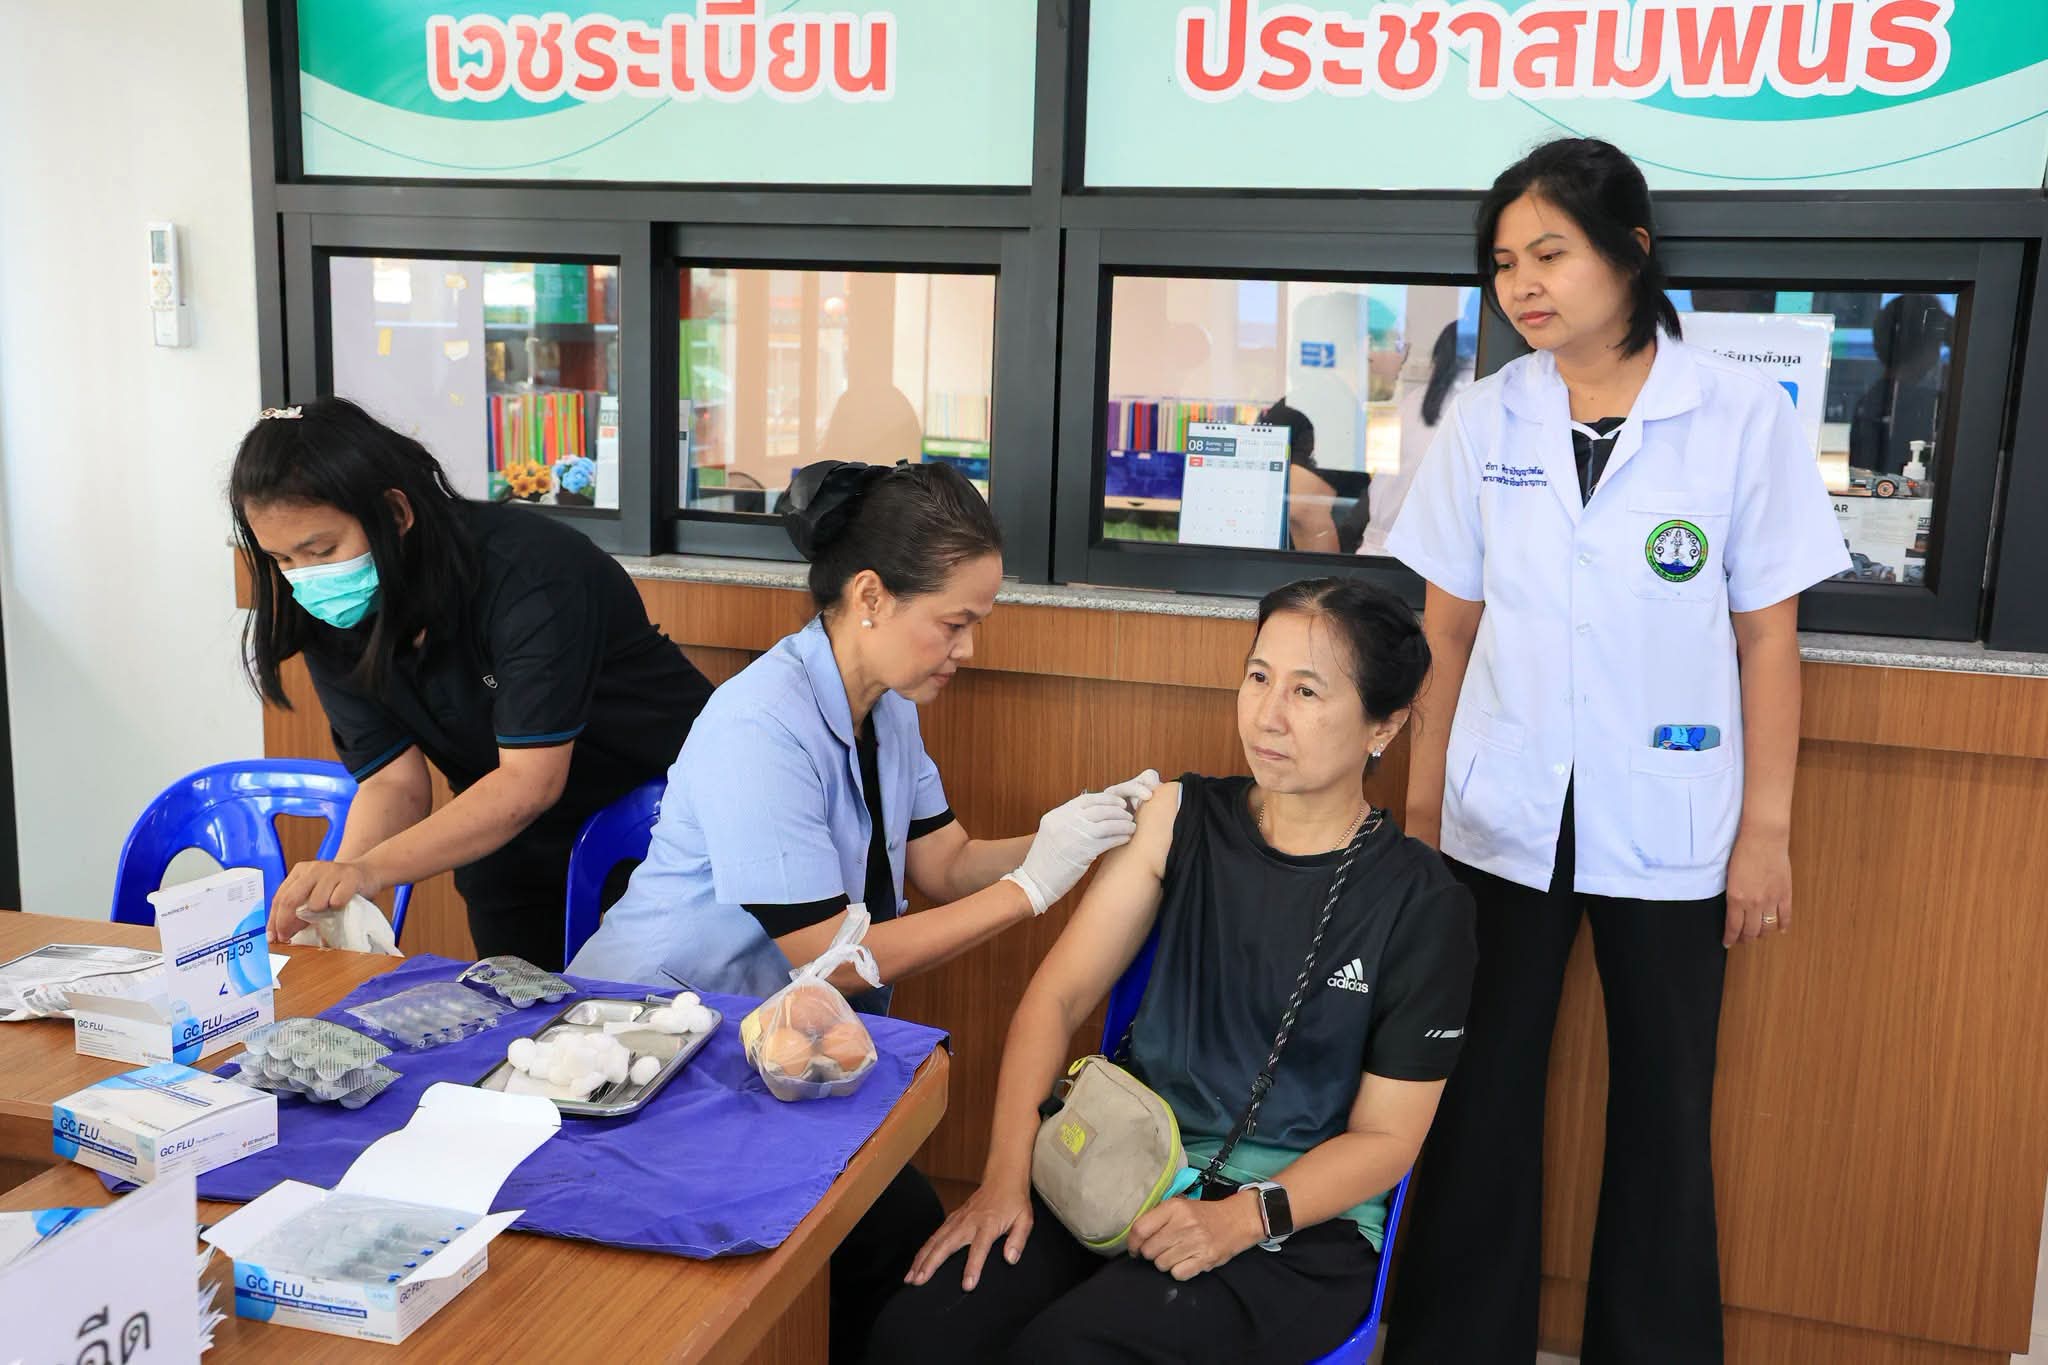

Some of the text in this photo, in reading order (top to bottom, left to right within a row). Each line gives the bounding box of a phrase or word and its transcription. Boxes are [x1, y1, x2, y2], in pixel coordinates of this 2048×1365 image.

[1188, 439, 1204, 452] 08
[216, 947, 236, 965] FLU
[238, 941, 254, 957] GC
[1327, 977, 1369, 993] adidas
[77, 1019, 104, 1031] GC FLU
[183, 1024, 199, 1040] GC
[201, 1014, 222, 1033] FLU
[60, 1117, 100, 1140] GC FLU
[160, 1145, 175, 1157] GC
[176, 1137, 195, 1152] FLU
[245, 1274, 304, 1298] GC FLU
[399, 1288, 411, 1304] GC
